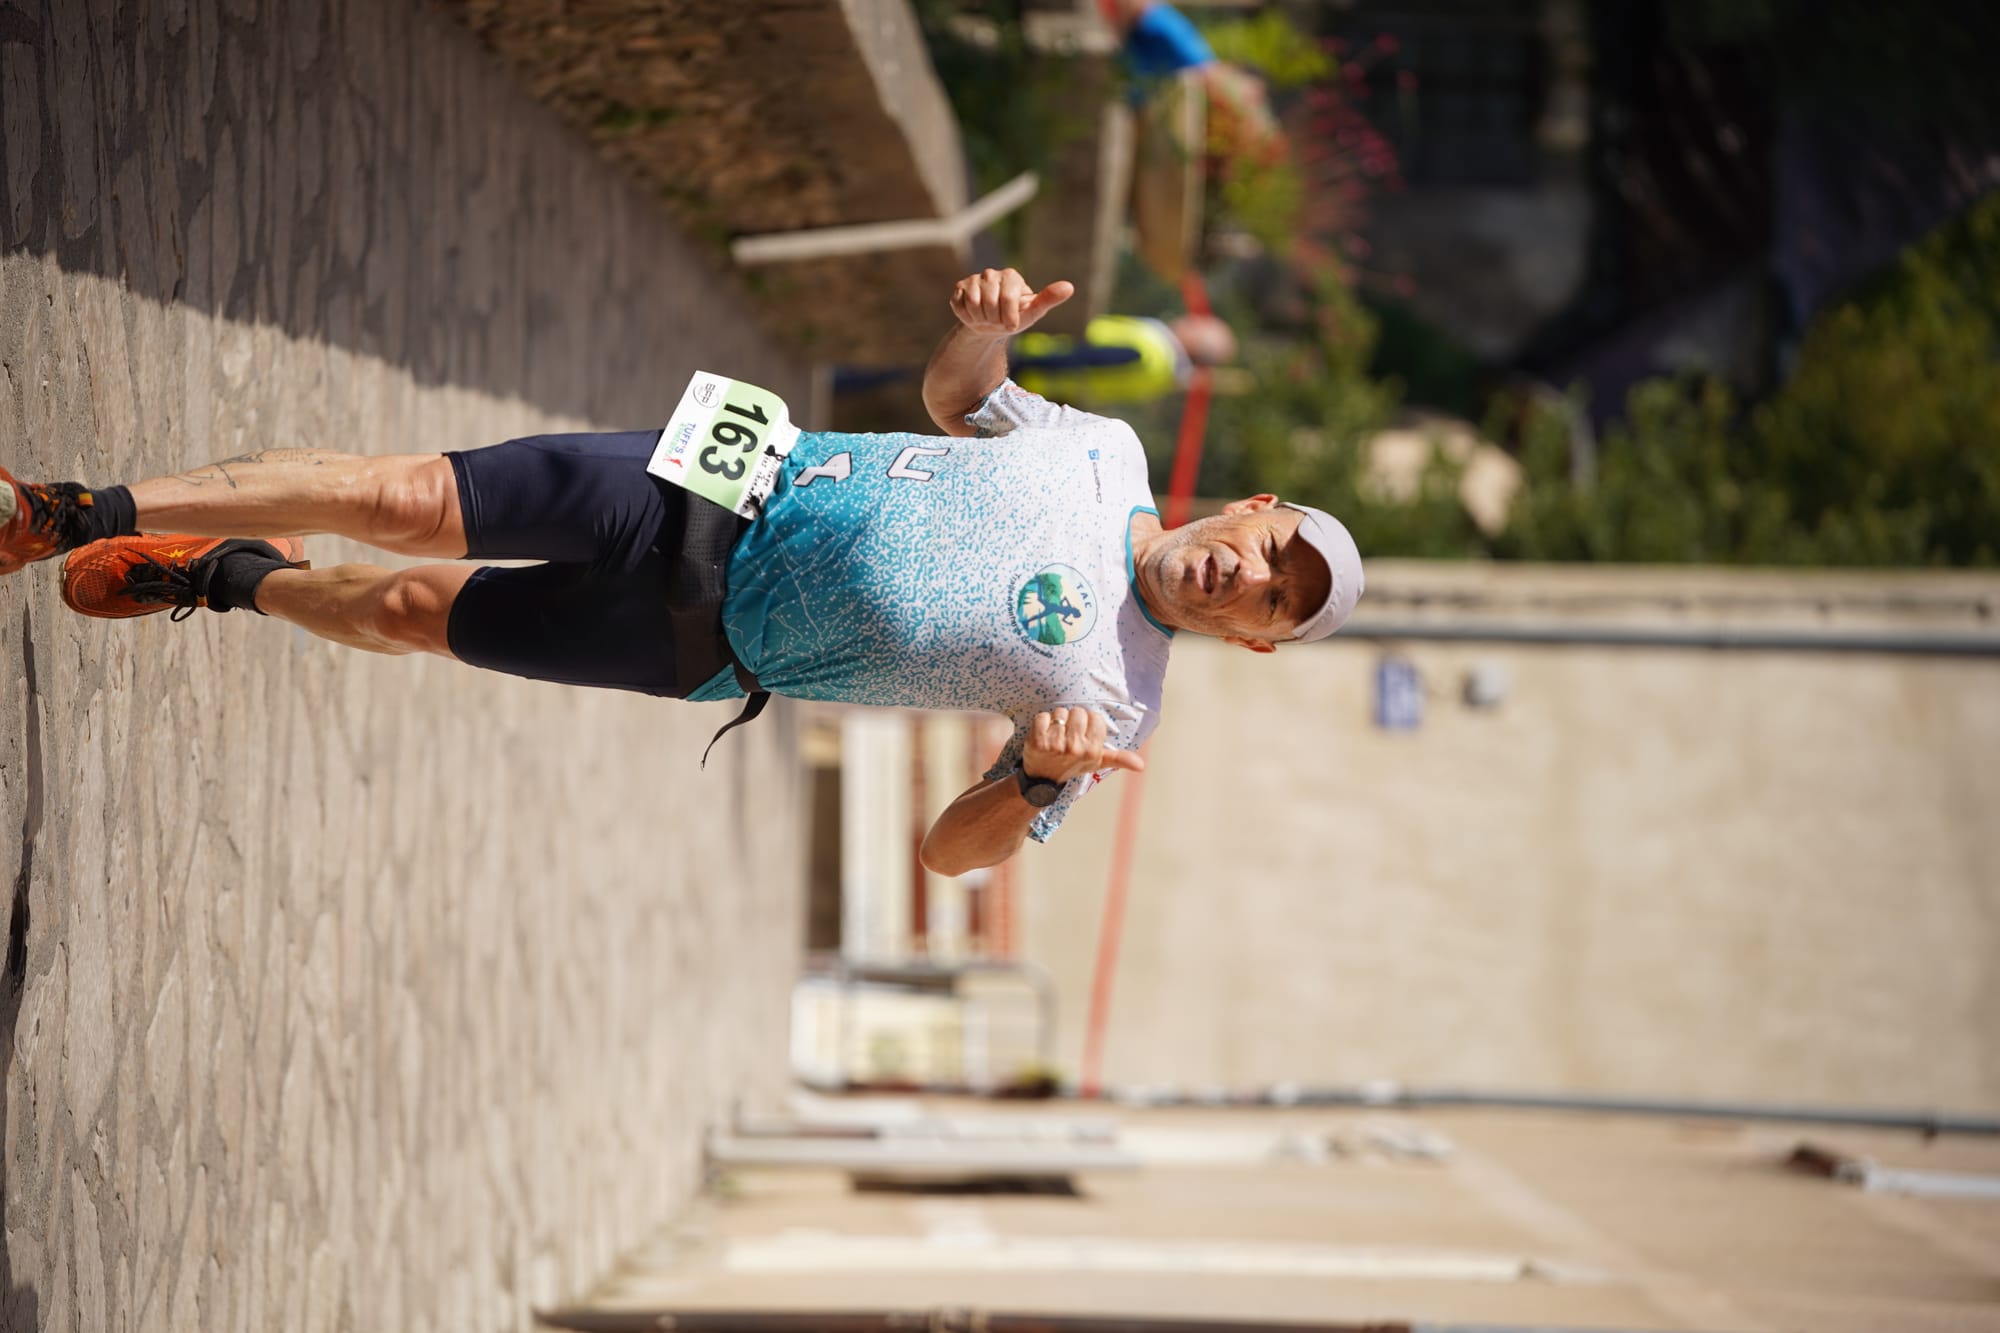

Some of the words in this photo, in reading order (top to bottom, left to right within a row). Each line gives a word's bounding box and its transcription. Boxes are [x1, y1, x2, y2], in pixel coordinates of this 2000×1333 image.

[674, 422, 697, 455] TUFF'S
[698, 402, 769, 481] 163
[1076, 583, 1092, 609] TAC
